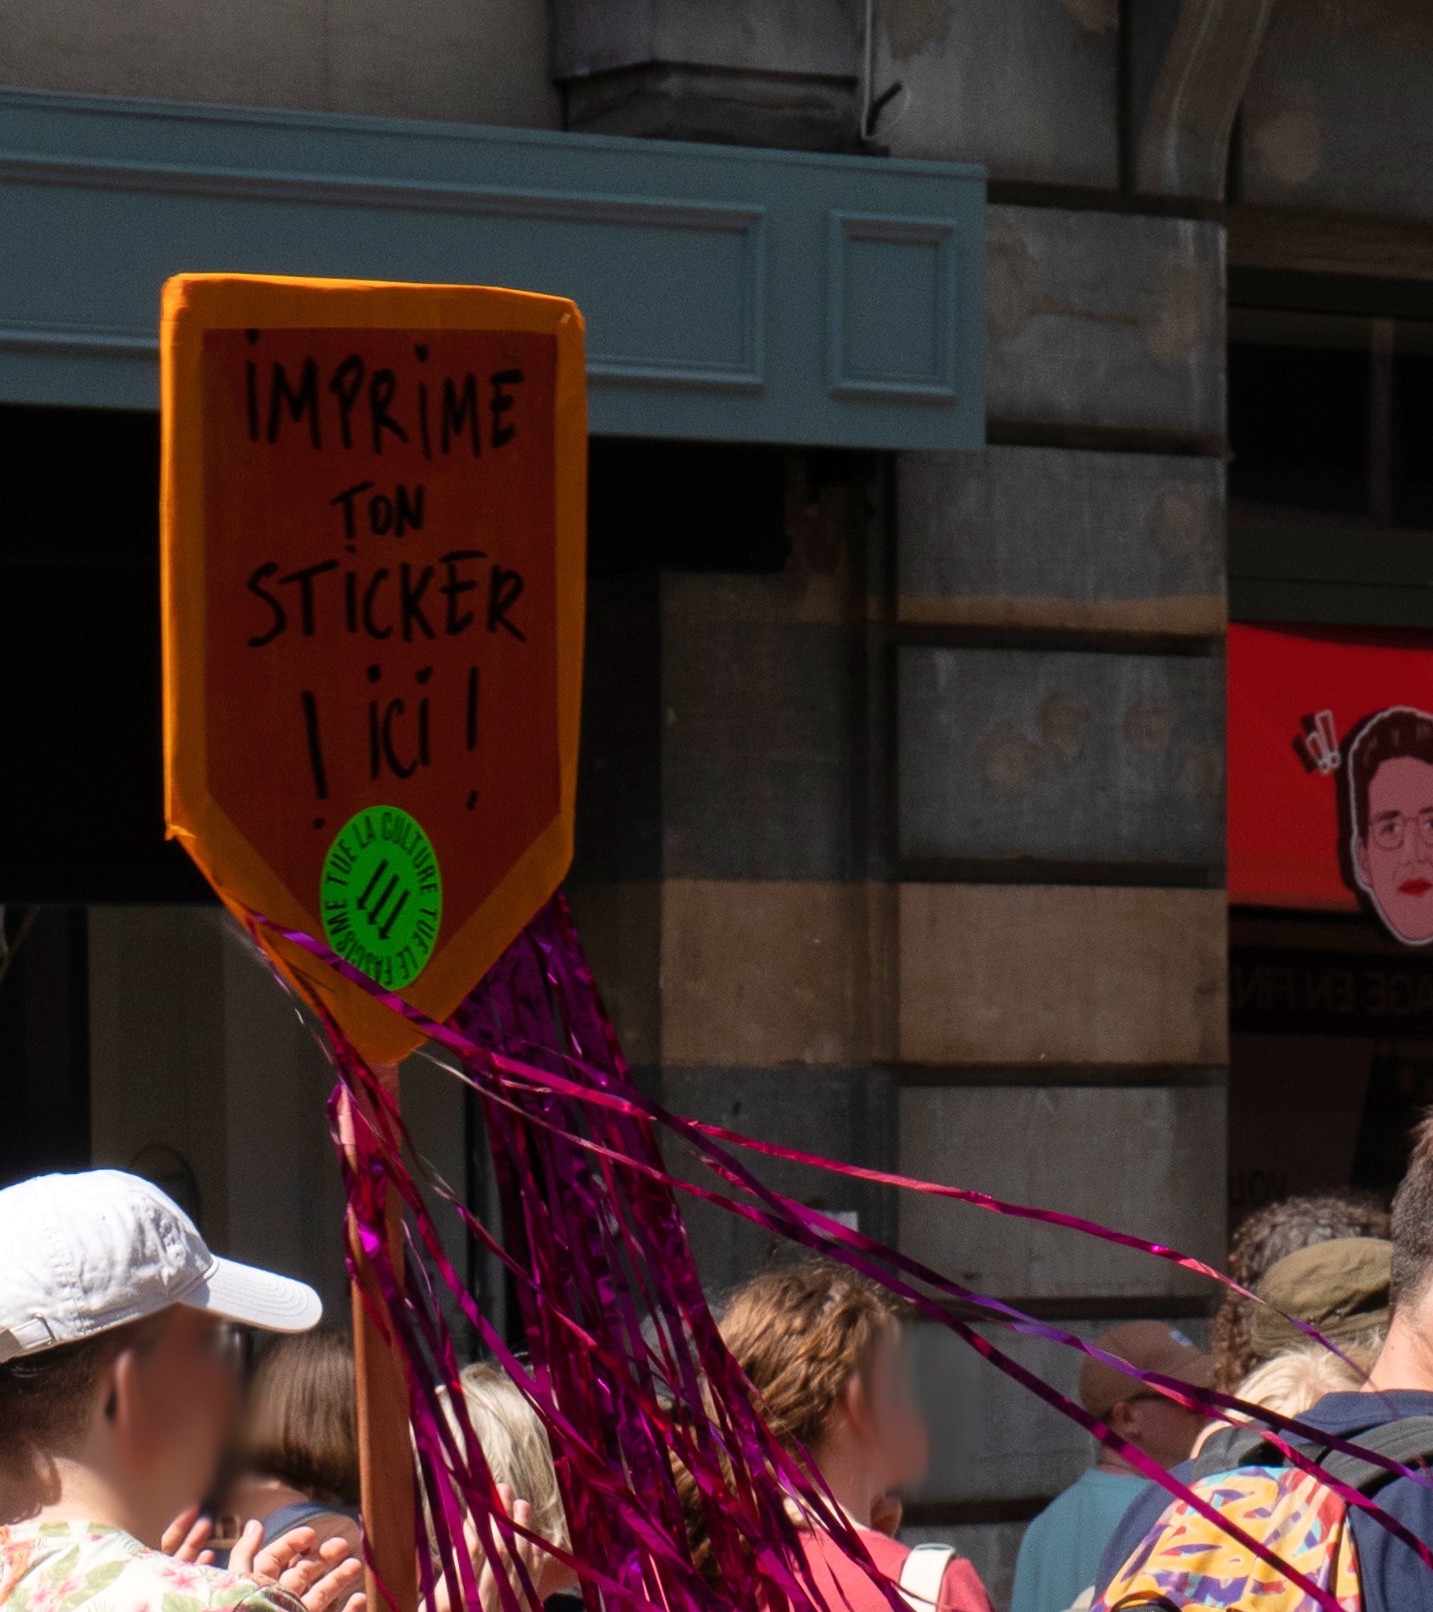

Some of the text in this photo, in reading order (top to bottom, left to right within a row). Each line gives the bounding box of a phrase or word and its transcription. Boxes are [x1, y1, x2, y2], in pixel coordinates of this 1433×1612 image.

[247, 545, 526, 647] STICKER
[353, 816, 376, 848] LA
[381, 812, 437, 895] CULTURE
[326, 838, 357, 886] TUE
[415, 908, 437, 955] TUE
[396, 945, 418, 980] LE
